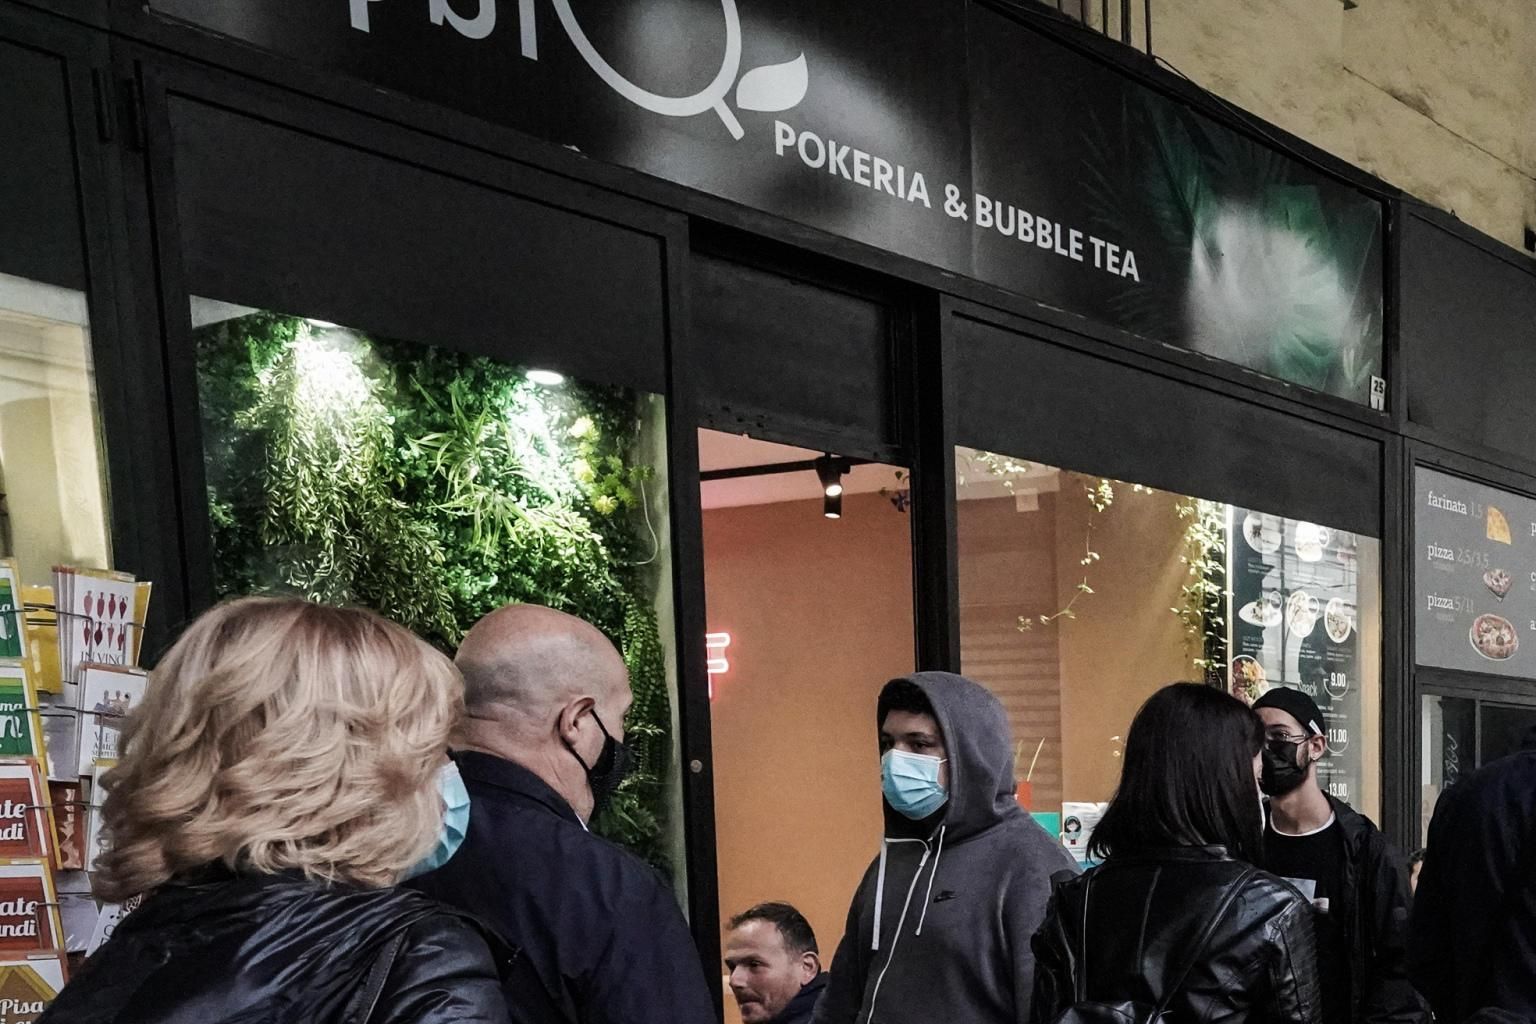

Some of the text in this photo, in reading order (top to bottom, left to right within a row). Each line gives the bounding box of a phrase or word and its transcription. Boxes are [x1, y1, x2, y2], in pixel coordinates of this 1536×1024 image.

[774, 119, 1141, 283] POKERIA & BUBBLE TEA
[1374, 379, 1384, 395] 25
[1427, 490, 1468, 515] farinata
[1427, 541, 1455, 561] pizza
[1427, 592, 1455, 611] pizza
[1330, 671, 1346, 688] 9.00
[1328, 728, 1348, 743] 11.00
[1328, 782, 1348, 797] 13.00
